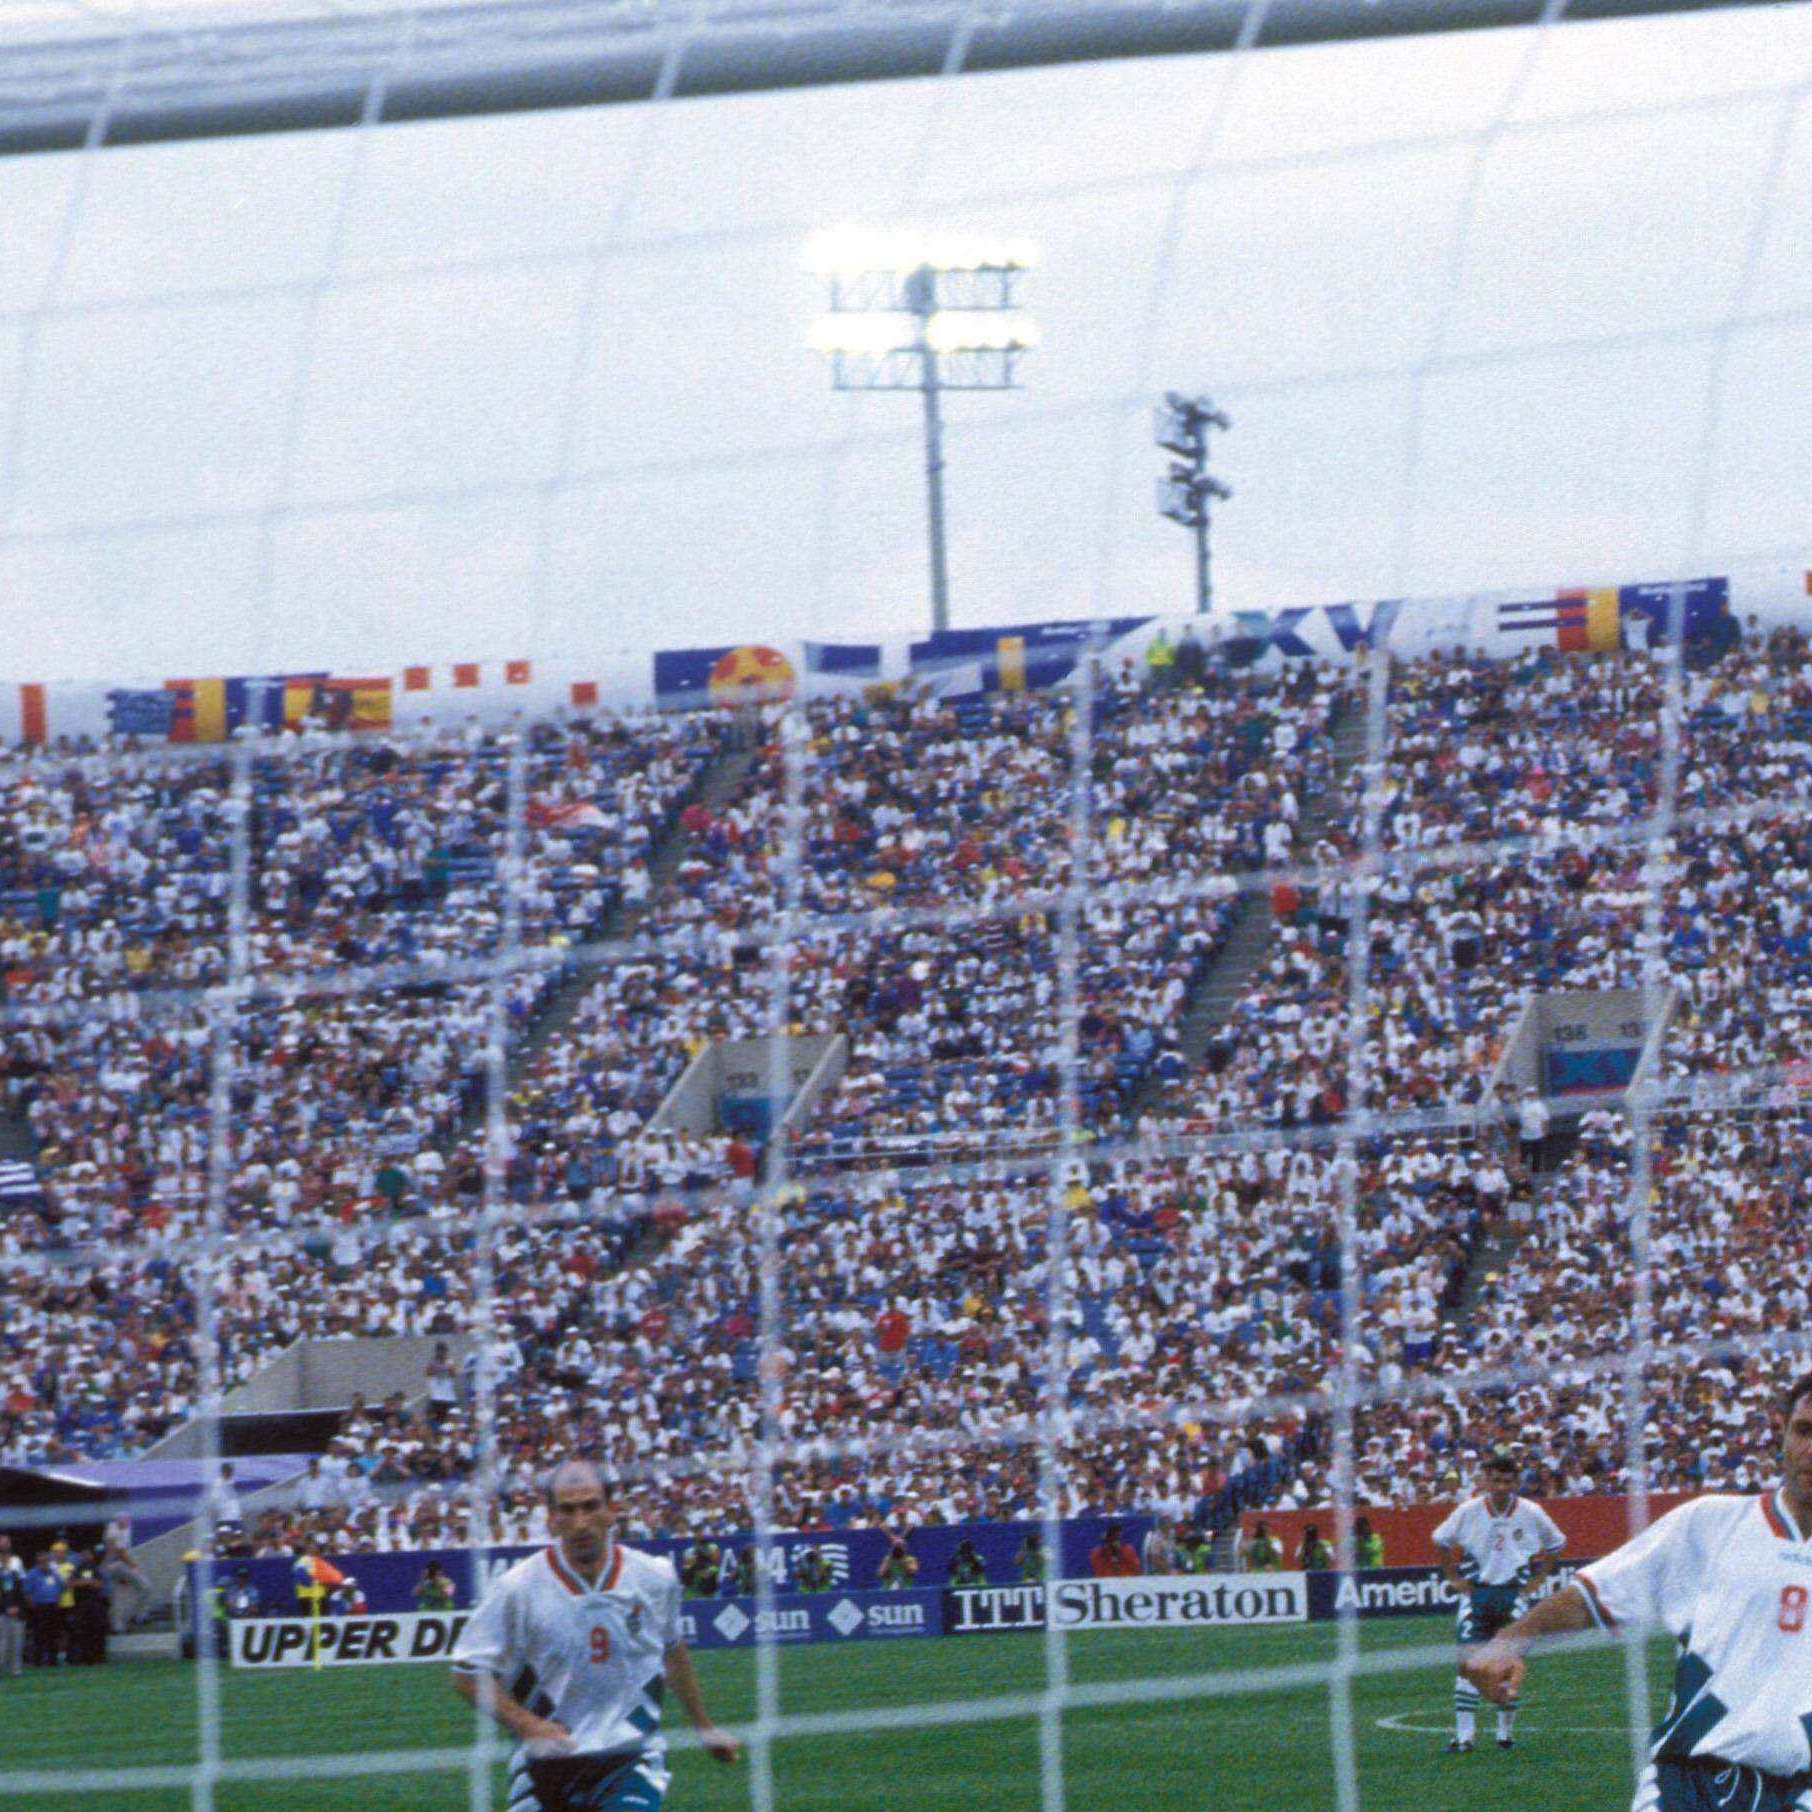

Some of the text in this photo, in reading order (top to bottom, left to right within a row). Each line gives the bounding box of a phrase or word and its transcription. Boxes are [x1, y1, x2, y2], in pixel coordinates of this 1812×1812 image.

[1054, 1580, 1299, 1624] Sheraton
[1335, 1572, 1460, 1609] Americ
[1777, 1584, 1808, 1634] 8
[754, 1604, 811, 1632] sun
[868, 1597, 924, 1627] sun
[241, 1621, 402, 1663] UPPER
[590, 1626, 611, 1664] 9
